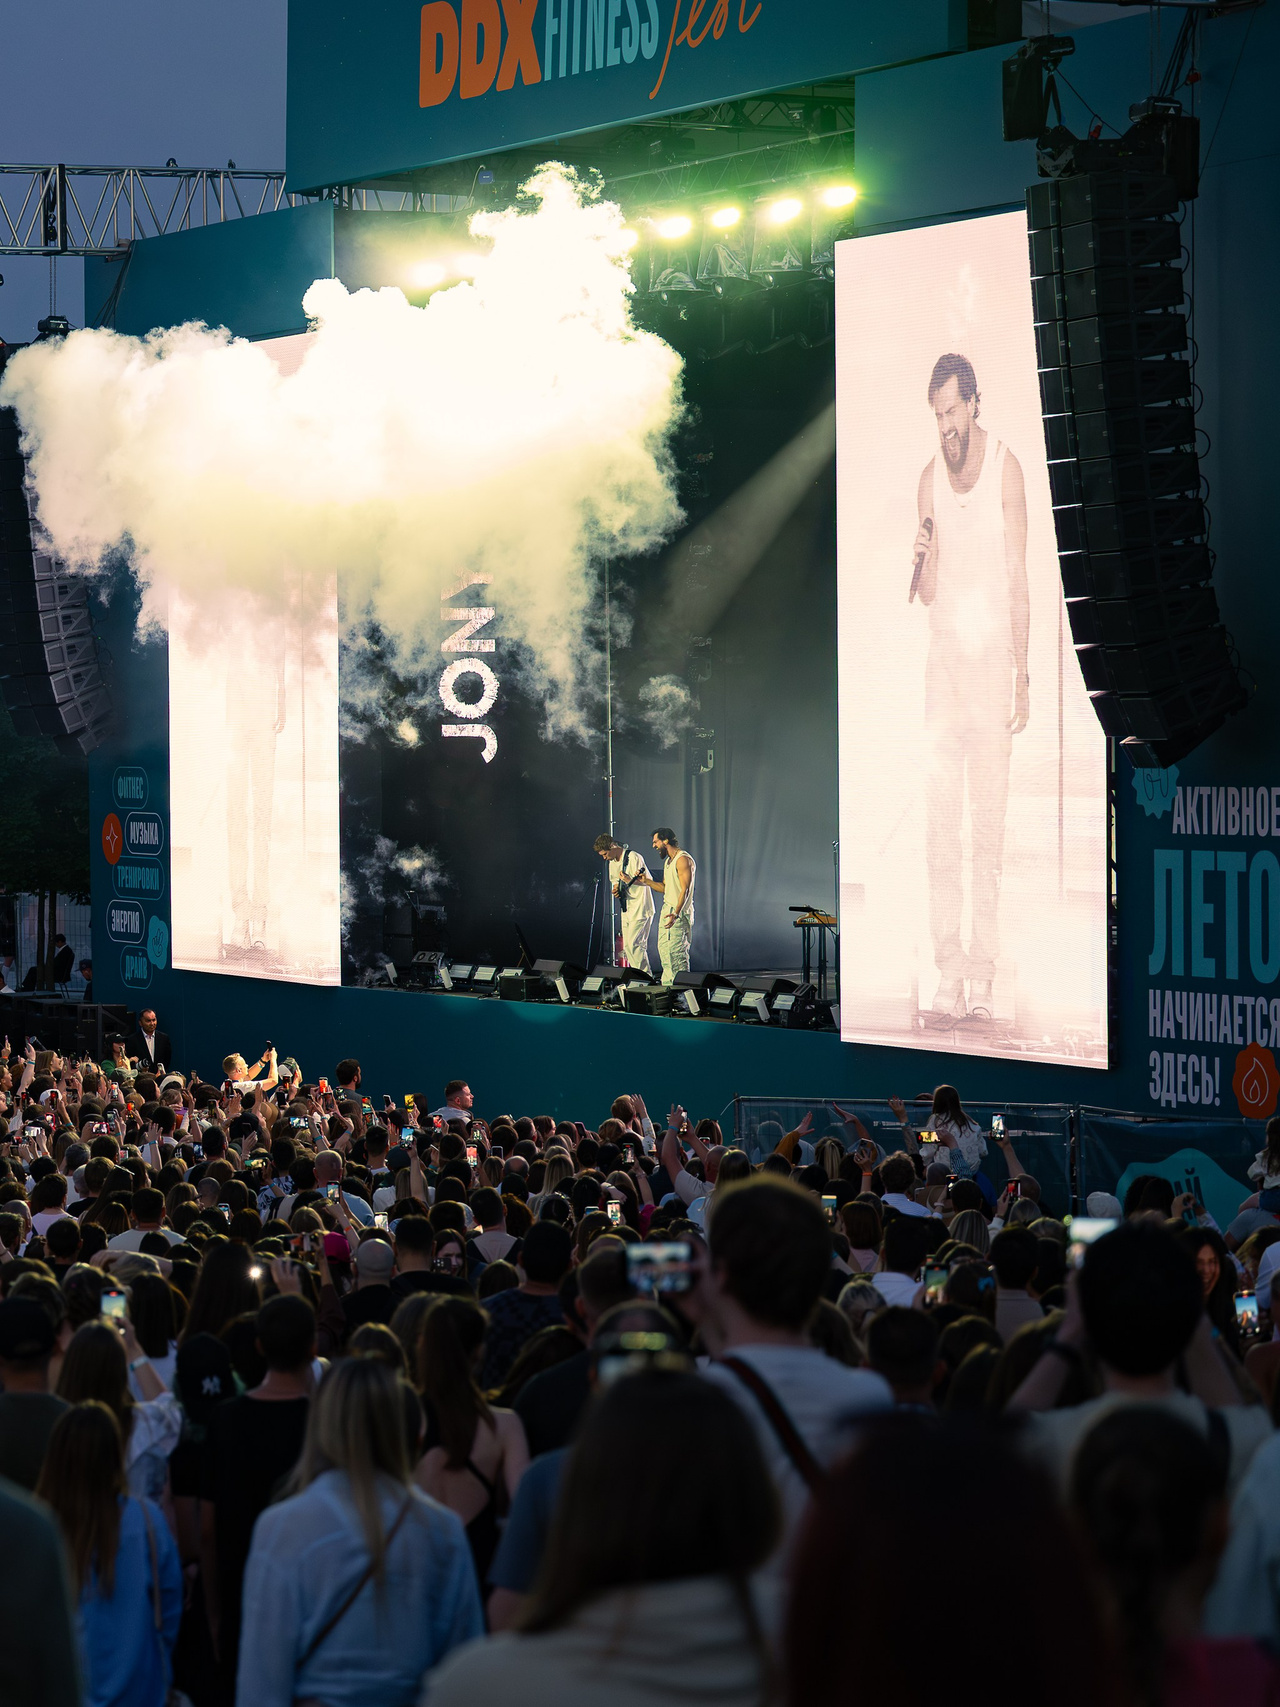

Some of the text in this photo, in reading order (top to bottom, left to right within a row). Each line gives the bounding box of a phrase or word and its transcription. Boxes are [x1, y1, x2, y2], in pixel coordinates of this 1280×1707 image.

[419, 0, 542, 108] DDX
[117, 775, 144, 799] ФИТНЕС
[1172, 785, 1280, 838] АКТИВНОЕ
[129, 821, 159, 845] МУЗЫКА
[117, 865, 160, 891] ТРЕНИРОВКИ
[111, 909, 140, 934] ЭНЕРГИЯ
[1148, 849, 1280, 984] ЛЕТО
[125, 951, 148, 981] ДРАЙВ
[1148, 988, 1280, 1049] НАЧИНАЕТСЯ
[1148, 1050, 1221, 1109] ЗДЕСЬ!
